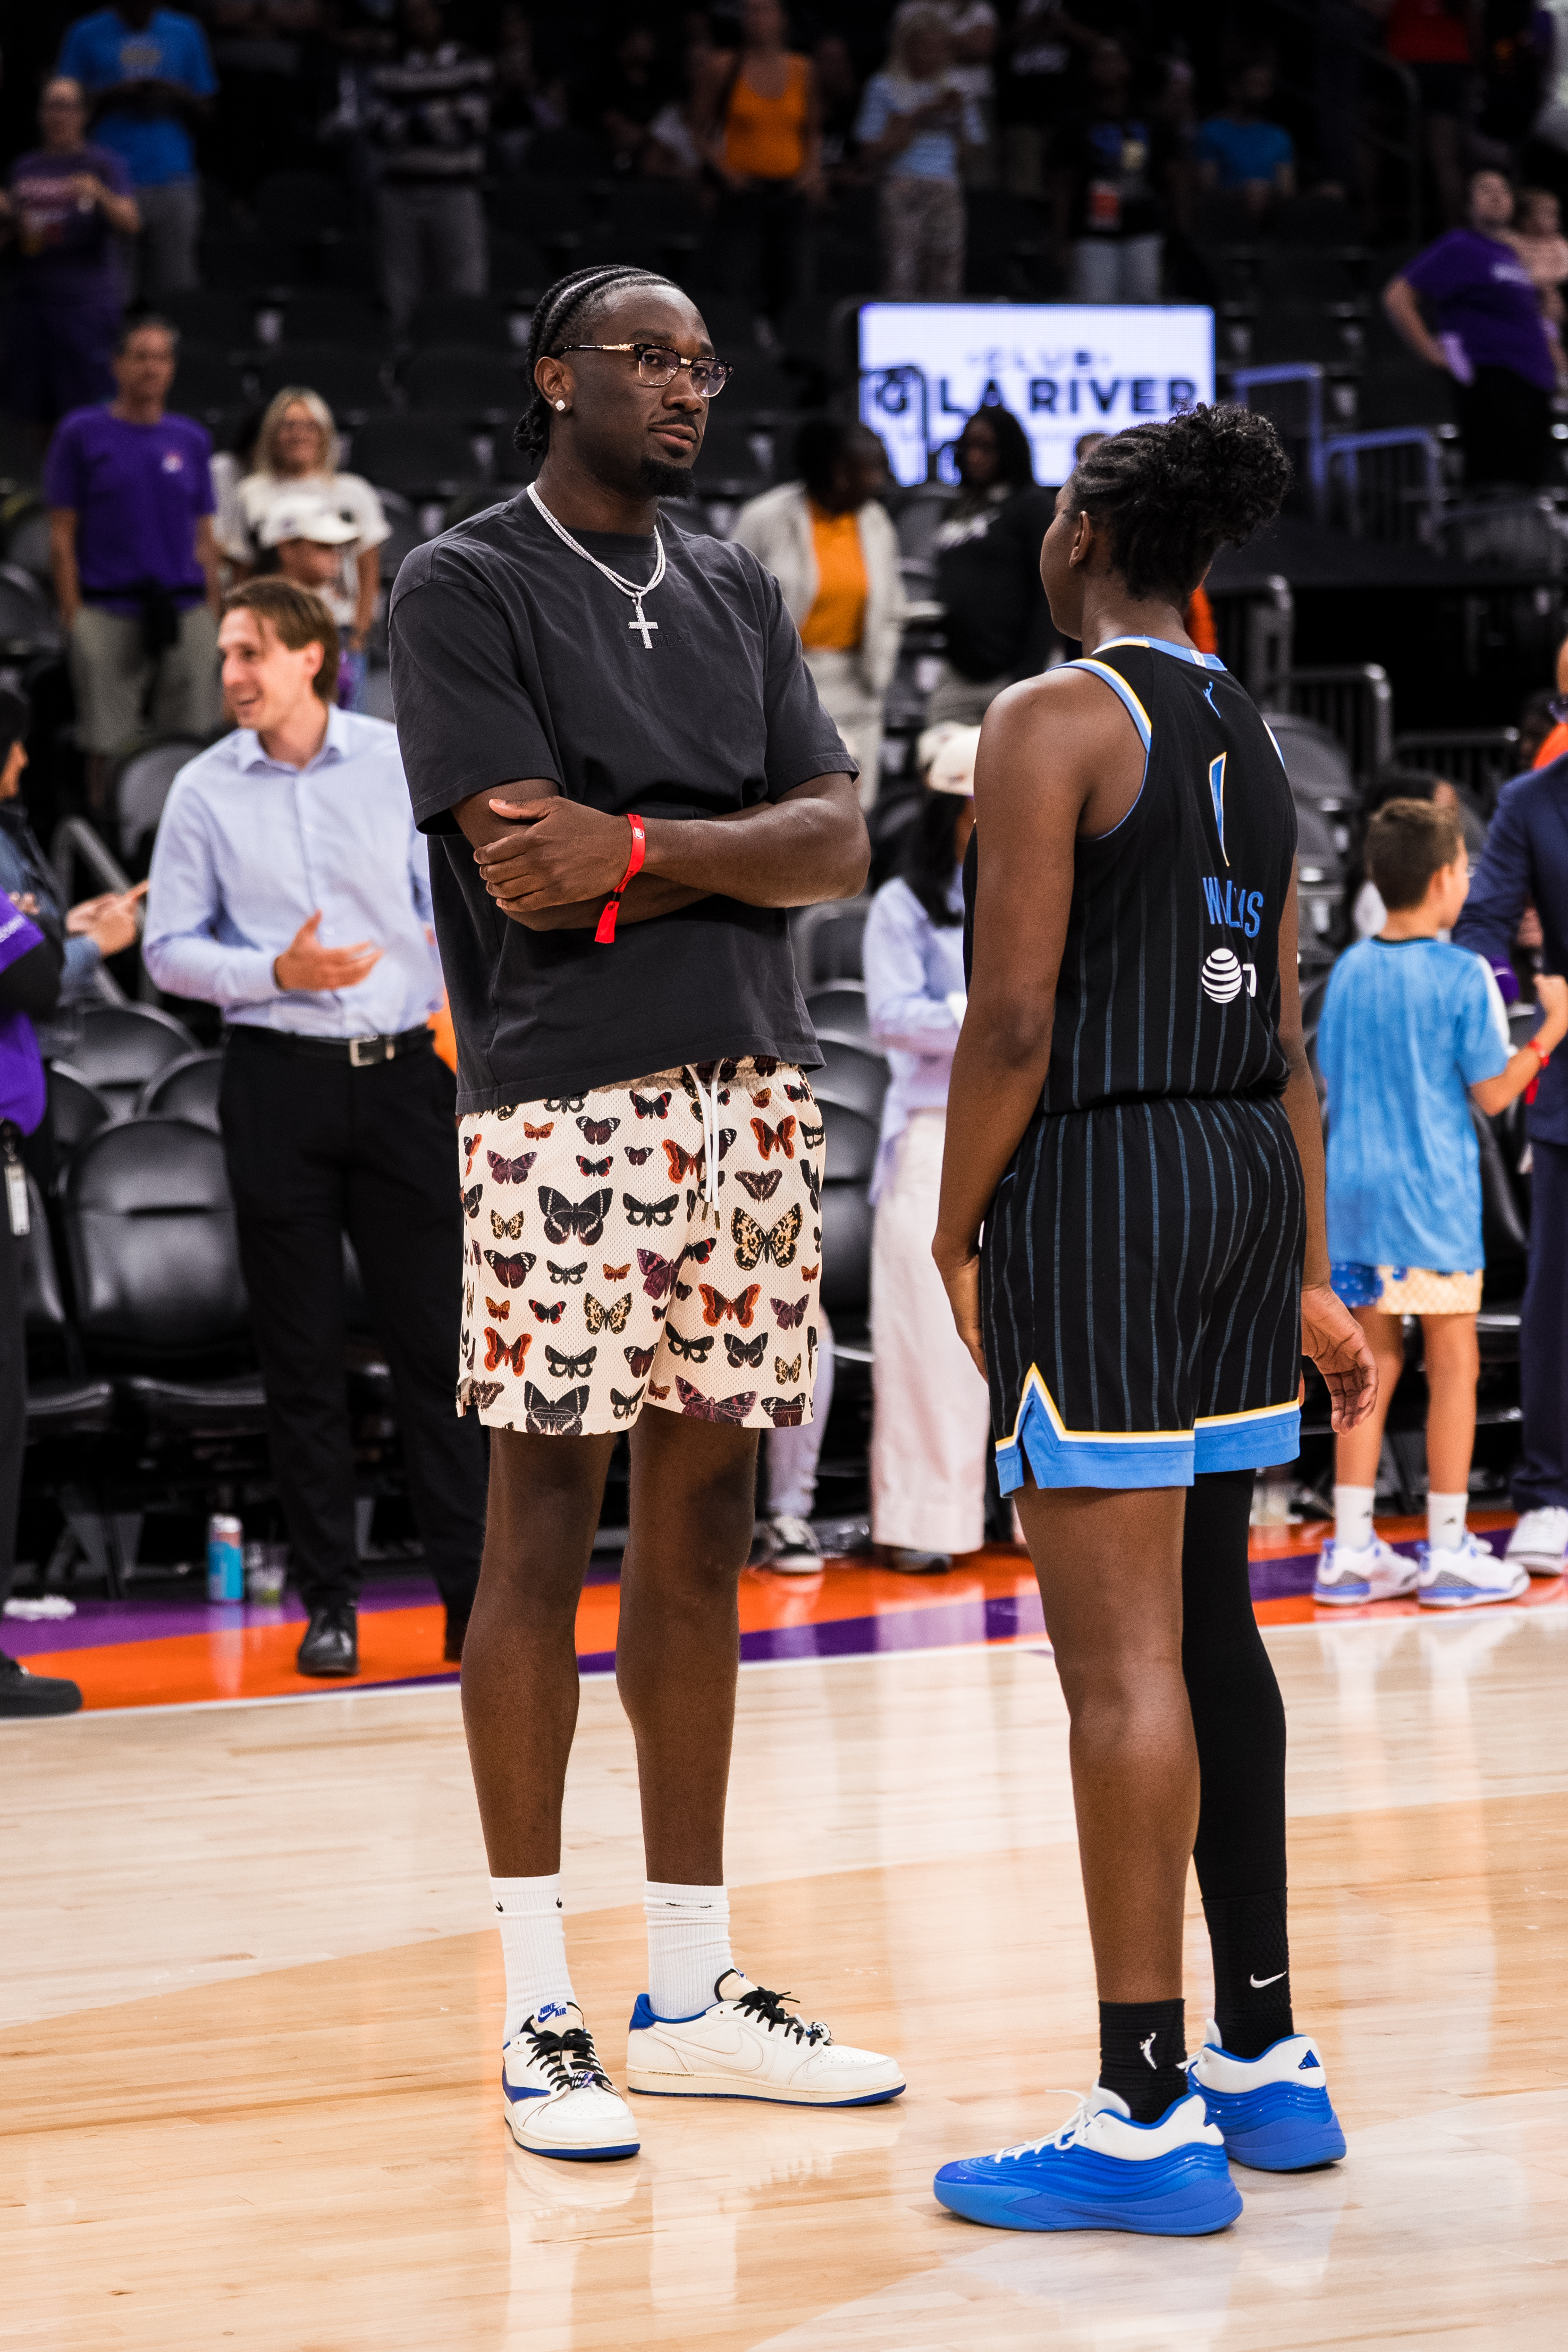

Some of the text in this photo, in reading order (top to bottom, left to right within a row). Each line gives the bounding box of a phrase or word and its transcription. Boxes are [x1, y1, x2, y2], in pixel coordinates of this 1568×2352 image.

[1029, 378, 1199, 415] RIVER
[540, 2002, 556, 2015] NIKE
[555, 2007, 567, 2017] AIR
